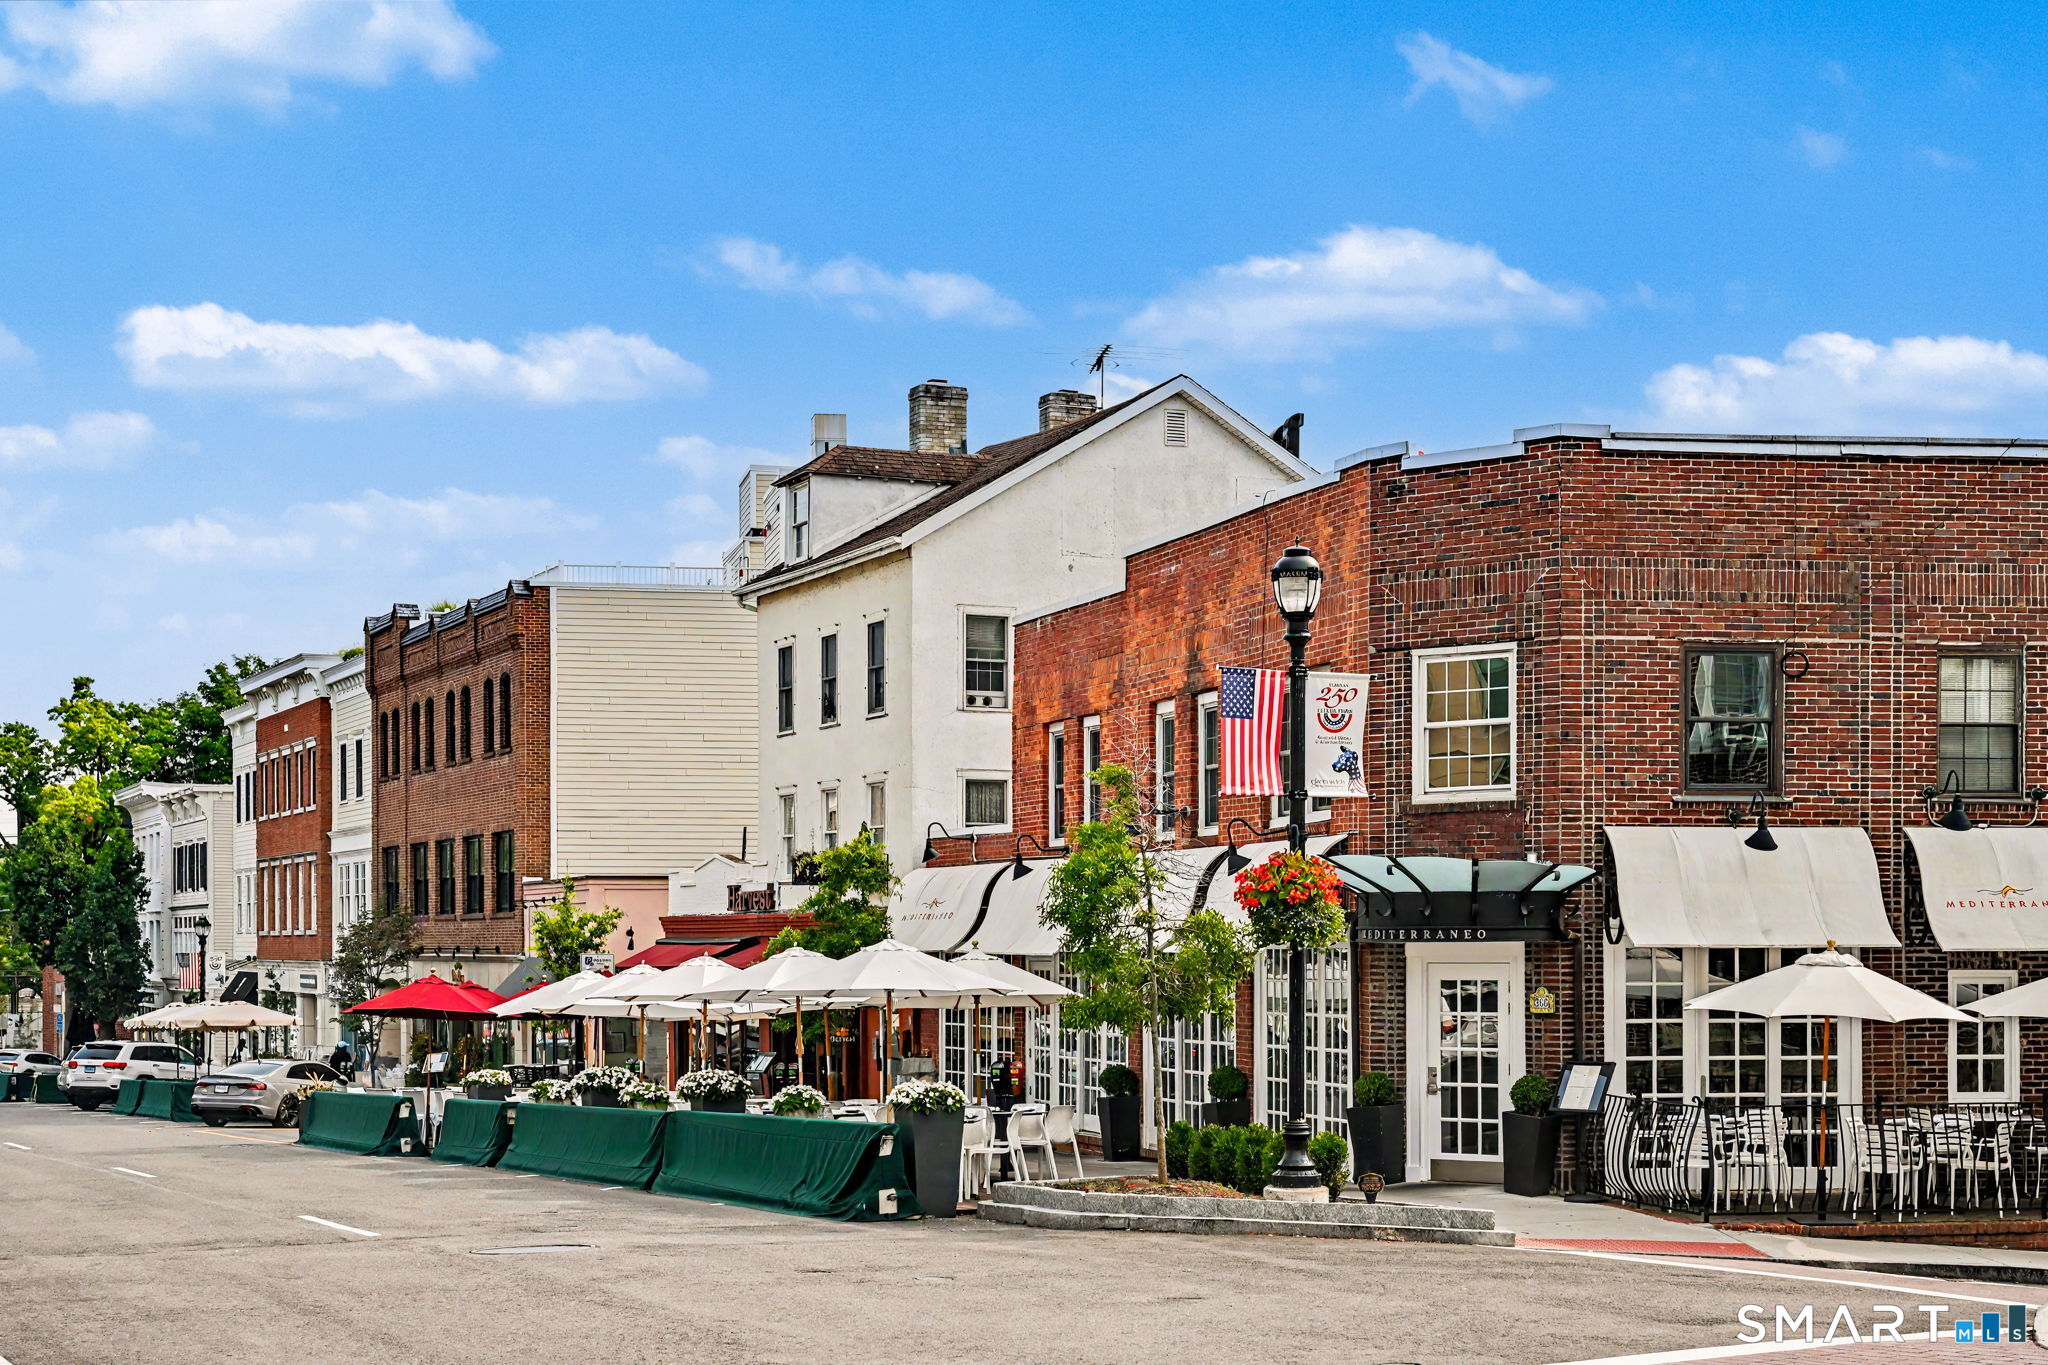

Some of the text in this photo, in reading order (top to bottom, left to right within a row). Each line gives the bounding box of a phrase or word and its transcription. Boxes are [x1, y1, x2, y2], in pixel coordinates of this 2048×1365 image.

[1316, 686, 1359, 709] 250
[727, 884, 775, 911] Harvest
[1361, 929, 1487, 940] MEDITERRANEO
